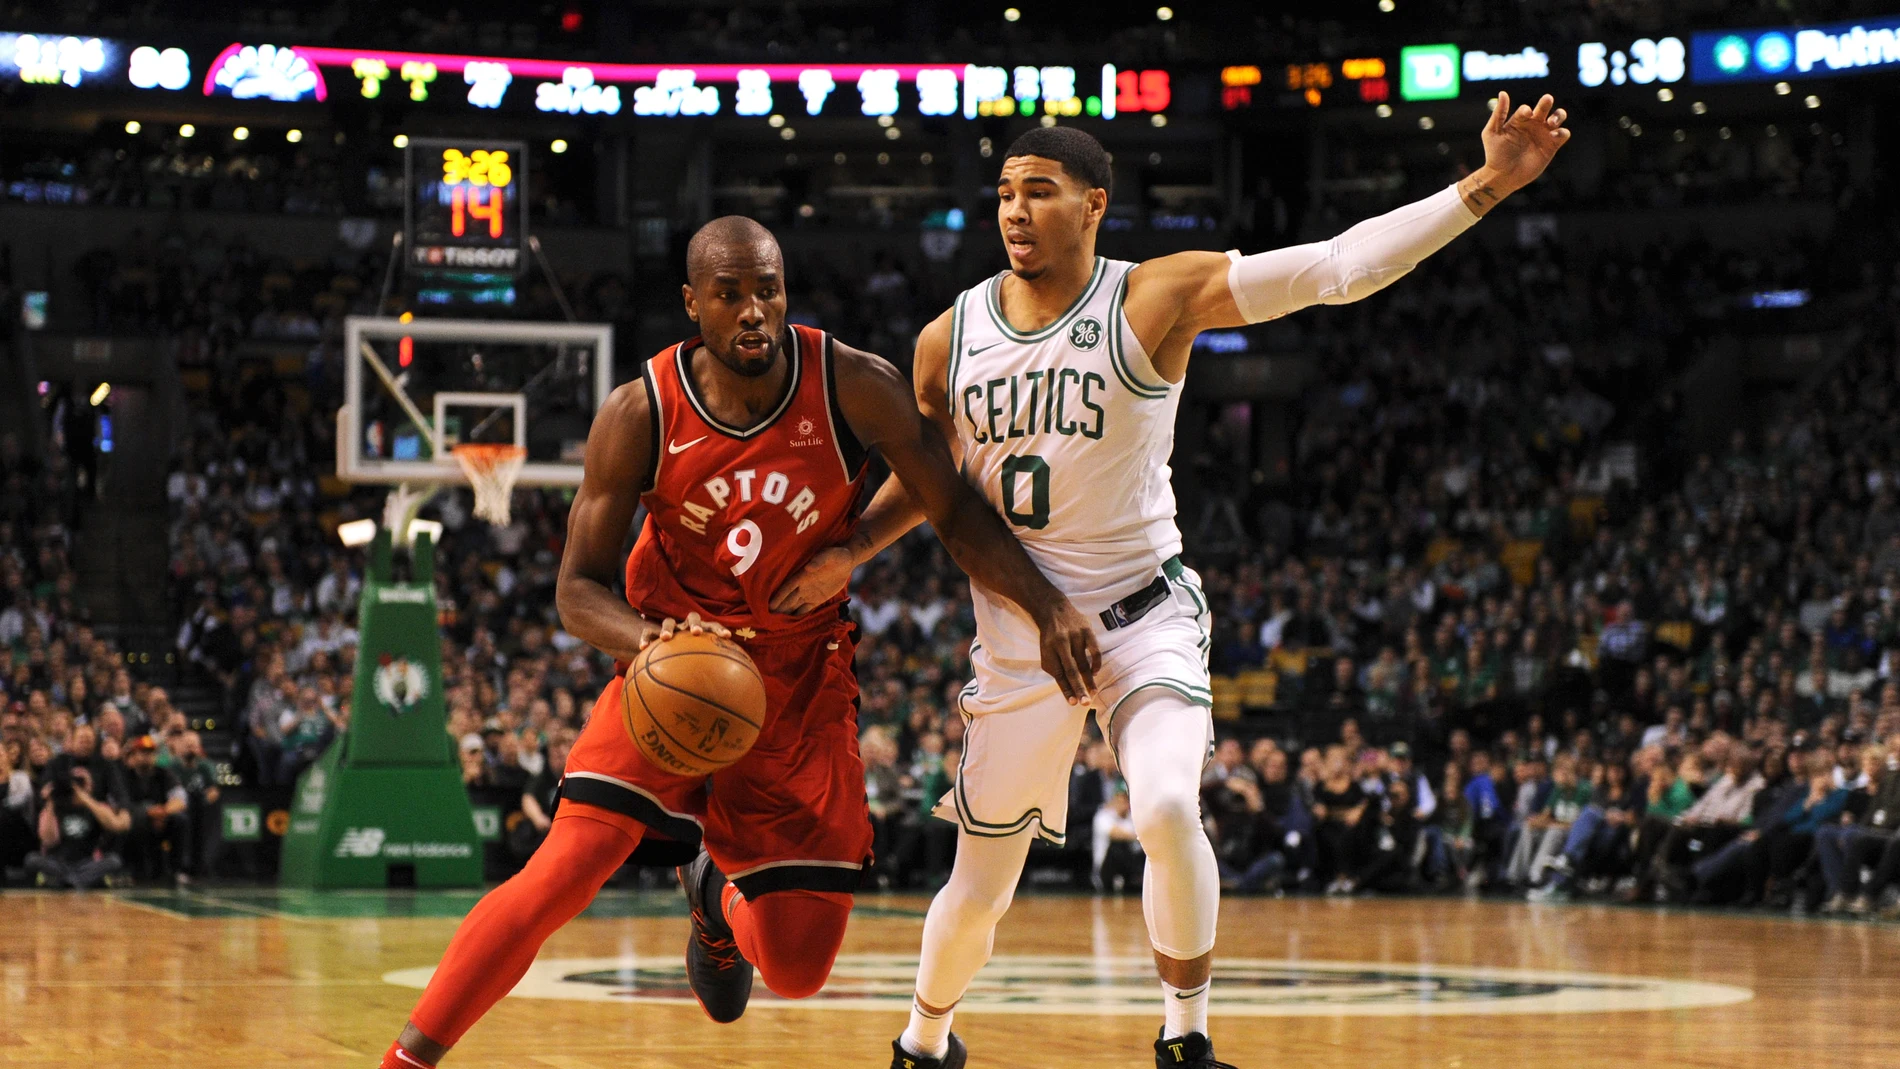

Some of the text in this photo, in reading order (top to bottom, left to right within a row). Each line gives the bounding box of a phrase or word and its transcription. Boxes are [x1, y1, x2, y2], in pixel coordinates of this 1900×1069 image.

[1115, 70, 1171, 112] 15
[1406, 54, 1454, 89] TD
[442, 149, 512, 187] 3:26
[452, 186, 503, 239] 14
[964, 368, 1106, 444] CELTICS
[789, 436, 824, 448] Sun Life
[679, 469, 820, 536] RAPTORS
[1002, 454, 1050, 530] 0
[726, 518, 763, 577] 9
